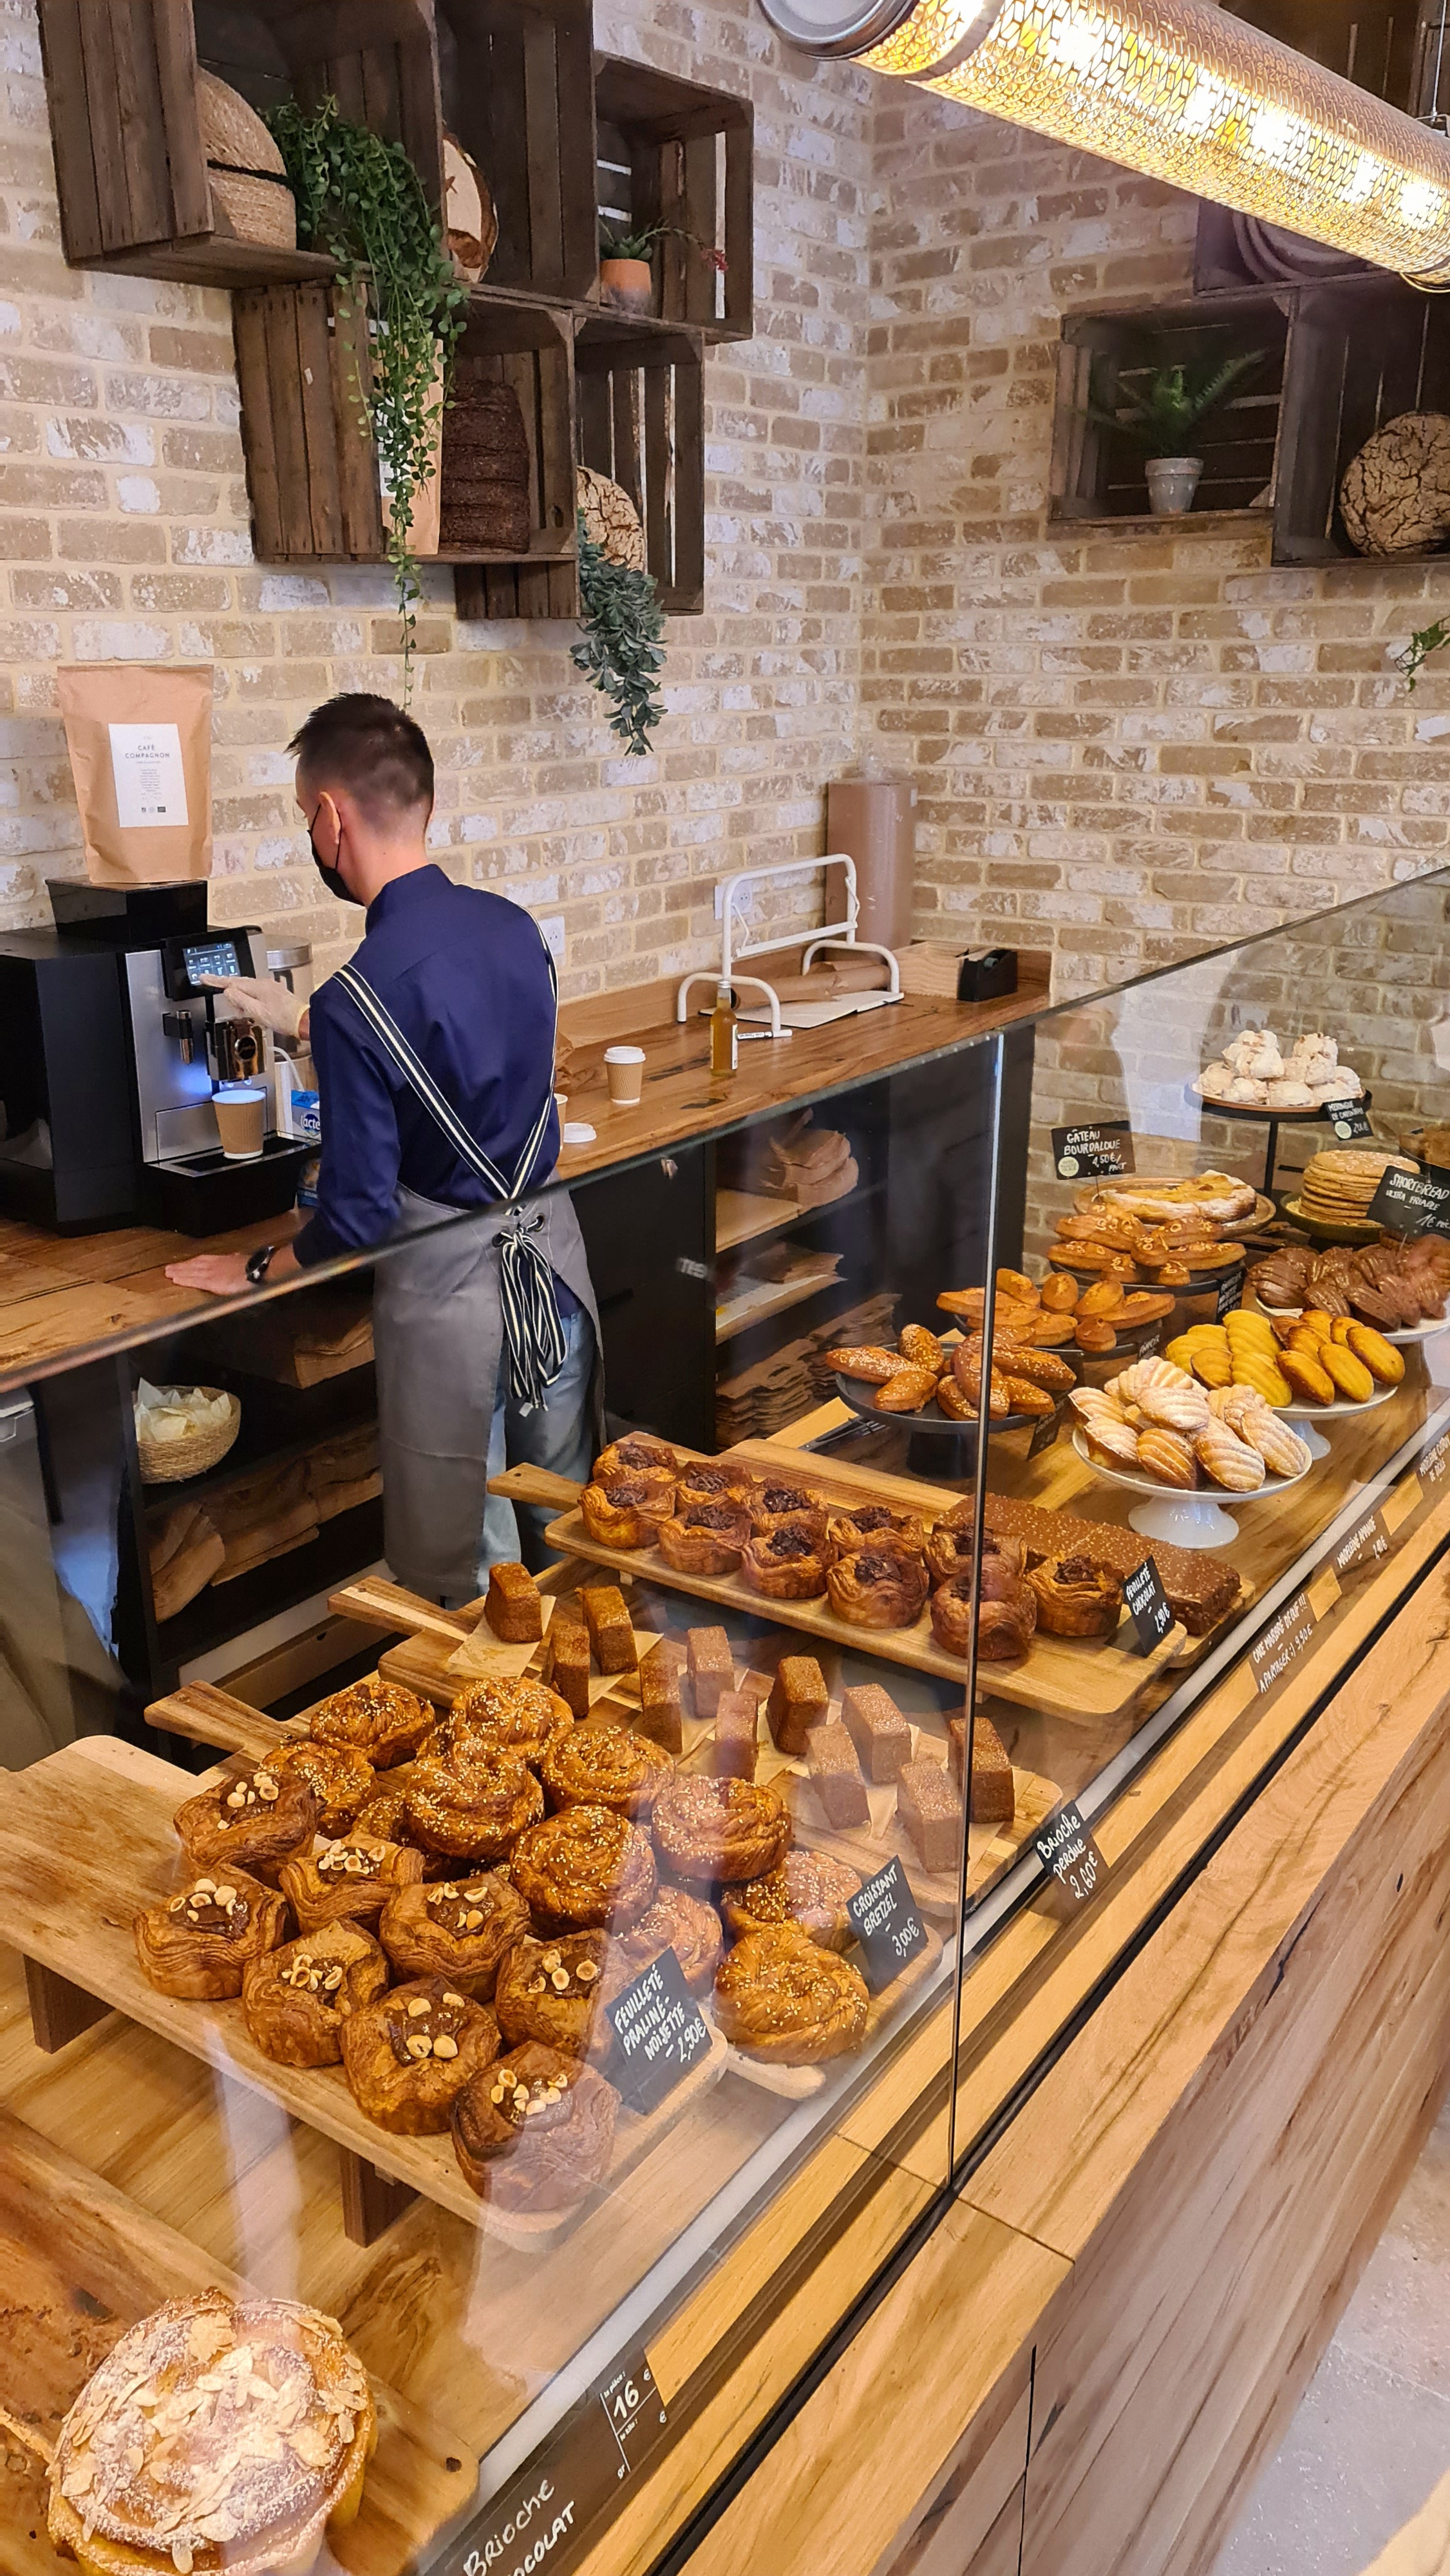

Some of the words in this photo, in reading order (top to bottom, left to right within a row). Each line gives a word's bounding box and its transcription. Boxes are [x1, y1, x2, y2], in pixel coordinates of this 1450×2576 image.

[1064, 1139, 1120, 1155] BOURDALOUE
[1066, 1129, 1100, 1144] GÂTEAU
[1109, 1162, 1127, 1172] PART
[1389, 1173, 1450, 1200] SHORTBREAD
[1126, 1562, 1151, 1601] FEUILLETÉ
[1132, 1580, 1156, 1616] CHOCOLAT
[1069, 1851, 1098, 1899] 2,60€
[863, 1892, 898, 1937] BRETZEL
[892, 1917, 919, 1957] 3,00€
[614, 1964, 664, 2034] FEUILLETÉ
[613, 2380, 639, 2419] 16
[509, 2500, 574, 2576] COLAT
